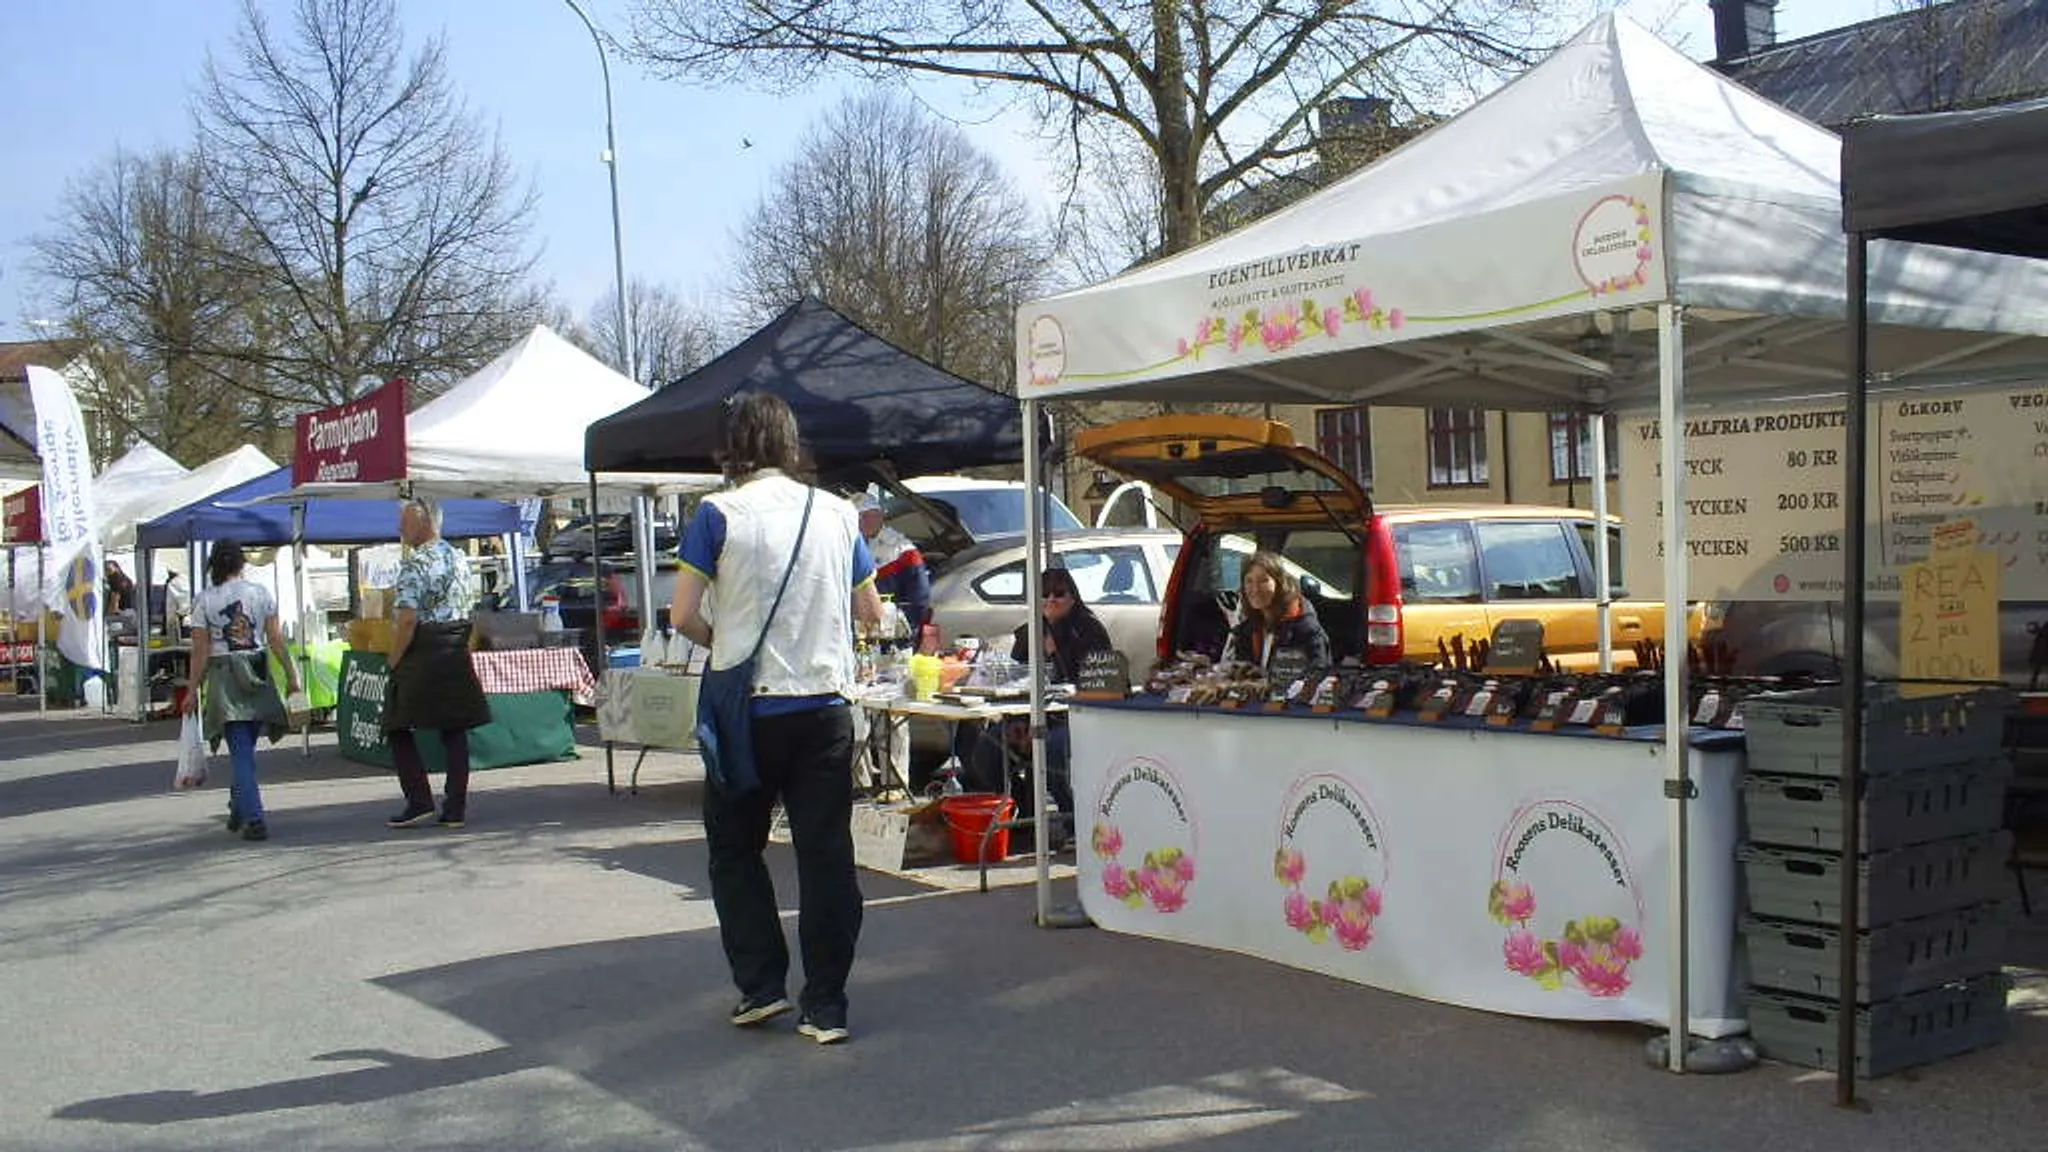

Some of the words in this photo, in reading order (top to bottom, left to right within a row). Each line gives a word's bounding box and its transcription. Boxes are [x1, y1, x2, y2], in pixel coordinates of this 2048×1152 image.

[1209, 244, 1361, 289] EGENTILLVERKAT
[307, 406, 378, 456] Parmigiano
[1786, 450, 1807, 468] 80
[1812, 449, 1838, 466] KR
[1777, 494, 1808, 510] 200
[1812, 492, 1839, 509] KR
[1779, 536, 1810, 553] 500
[1815, 535, 1841, 551] KR
[1914, 562, 1986, 601] REA
[1908, 613, 1931, 643] 2
[1506, 819, 1547, 873] Roosens
[1547, 811, 1626, 887] Delikatesser
